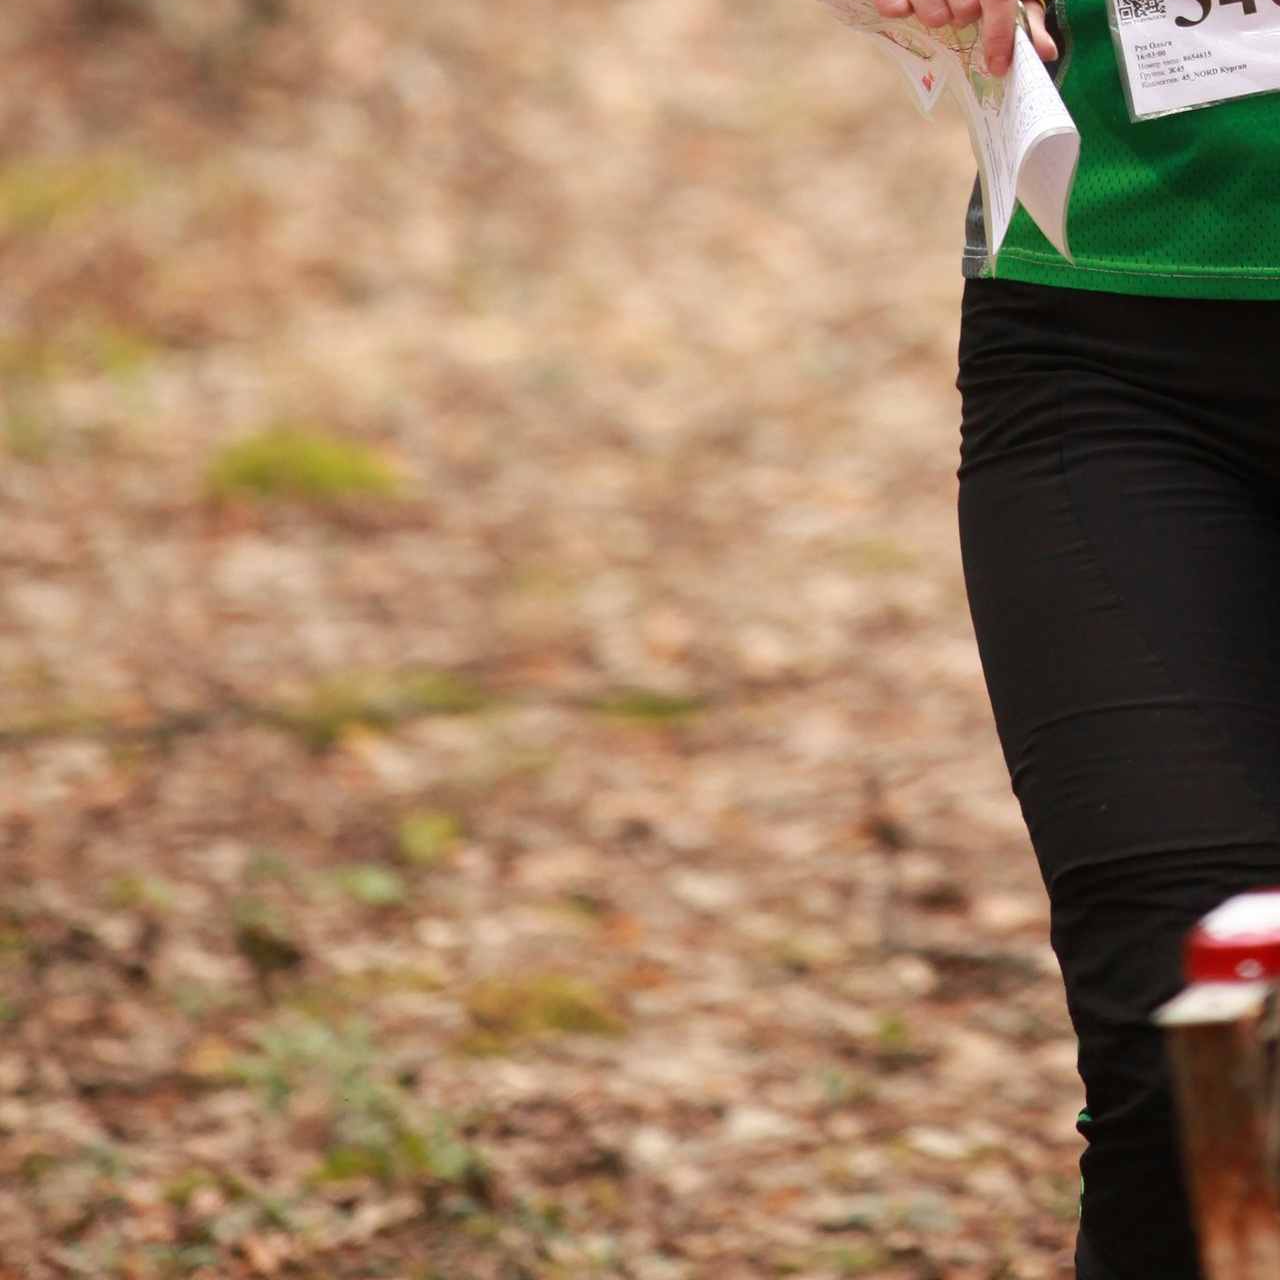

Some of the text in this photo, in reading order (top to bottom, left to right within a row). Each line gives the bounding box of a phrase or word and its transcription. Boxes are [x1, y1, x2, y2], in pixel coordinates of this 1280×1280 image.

[1149, 40, 1172, 49] Ольга
[1136, 50, 1166, 61] 16:03:00
[1183, 50, 1212, 62] 8654615
[1168, 66, 1185, 75] Ж45
[1181, 68, 1218, 82] 45_NORD
[1220, 63, 1247, 74] Курган
